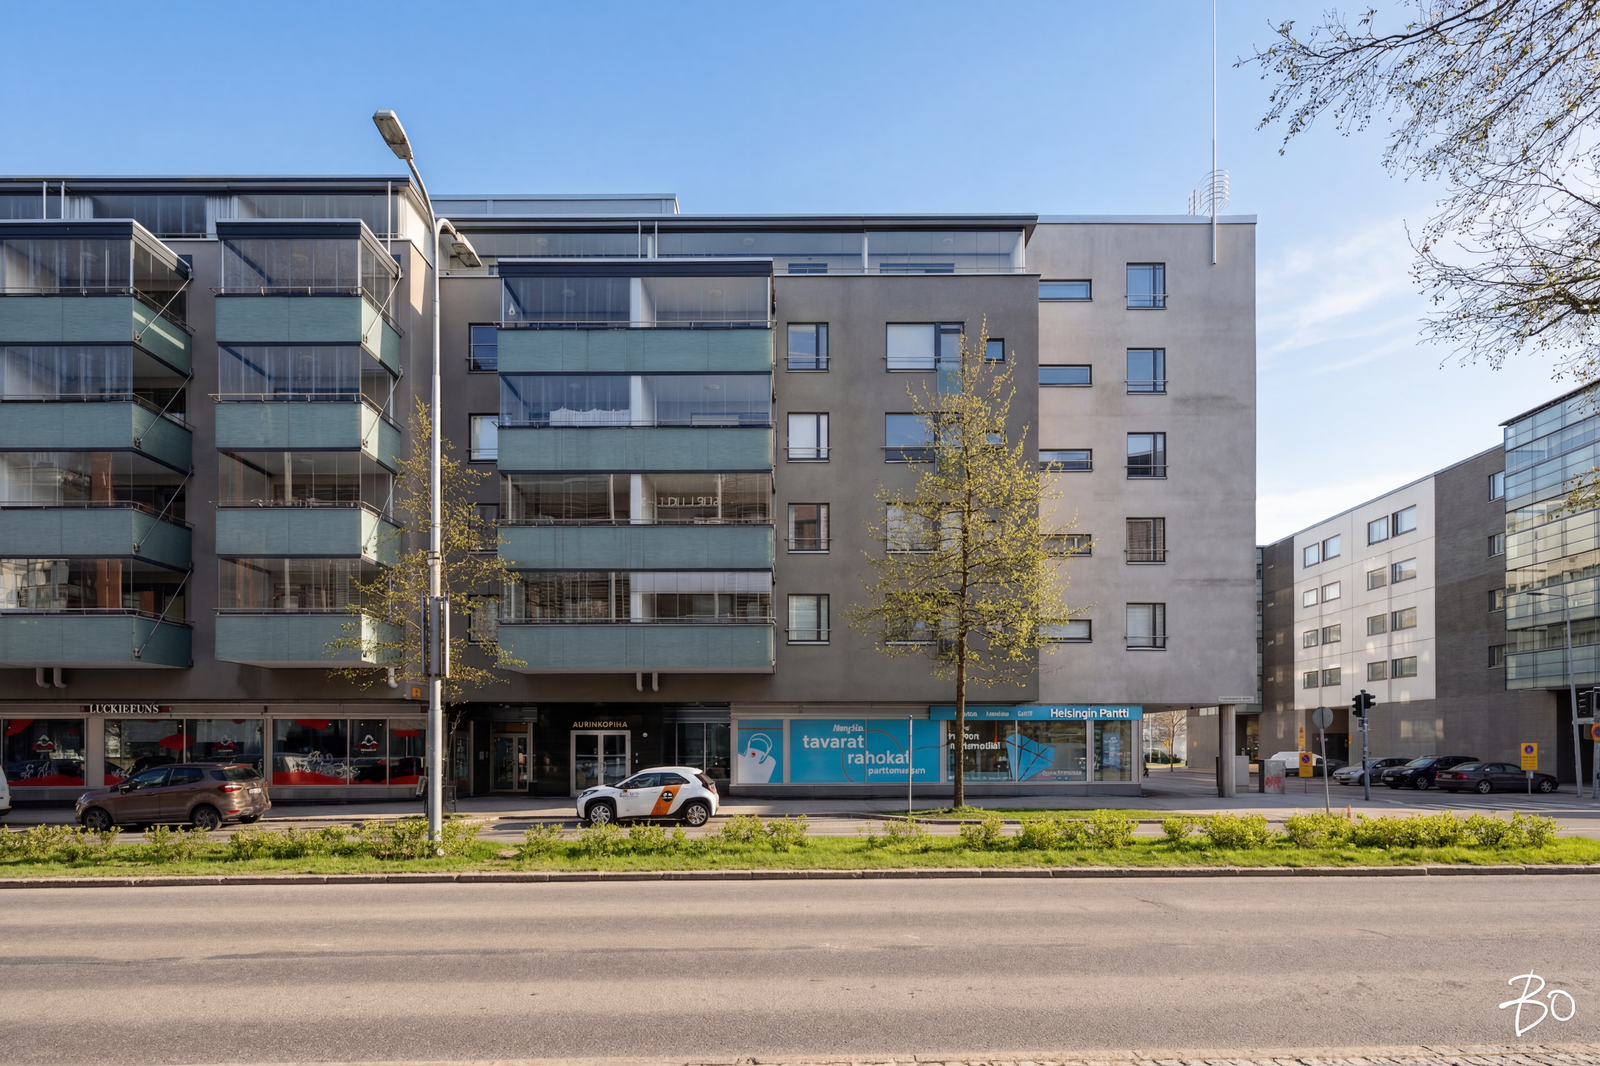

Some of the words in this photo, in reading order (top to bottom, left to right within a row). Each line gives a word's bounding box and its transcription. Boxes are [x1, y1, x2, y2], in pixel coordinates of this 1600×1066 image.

[1050, 708, 1098, 719] Helsingin
[1099, 708, 1129, 717] Pantti
[803, 735, 864, 749] tavarat
